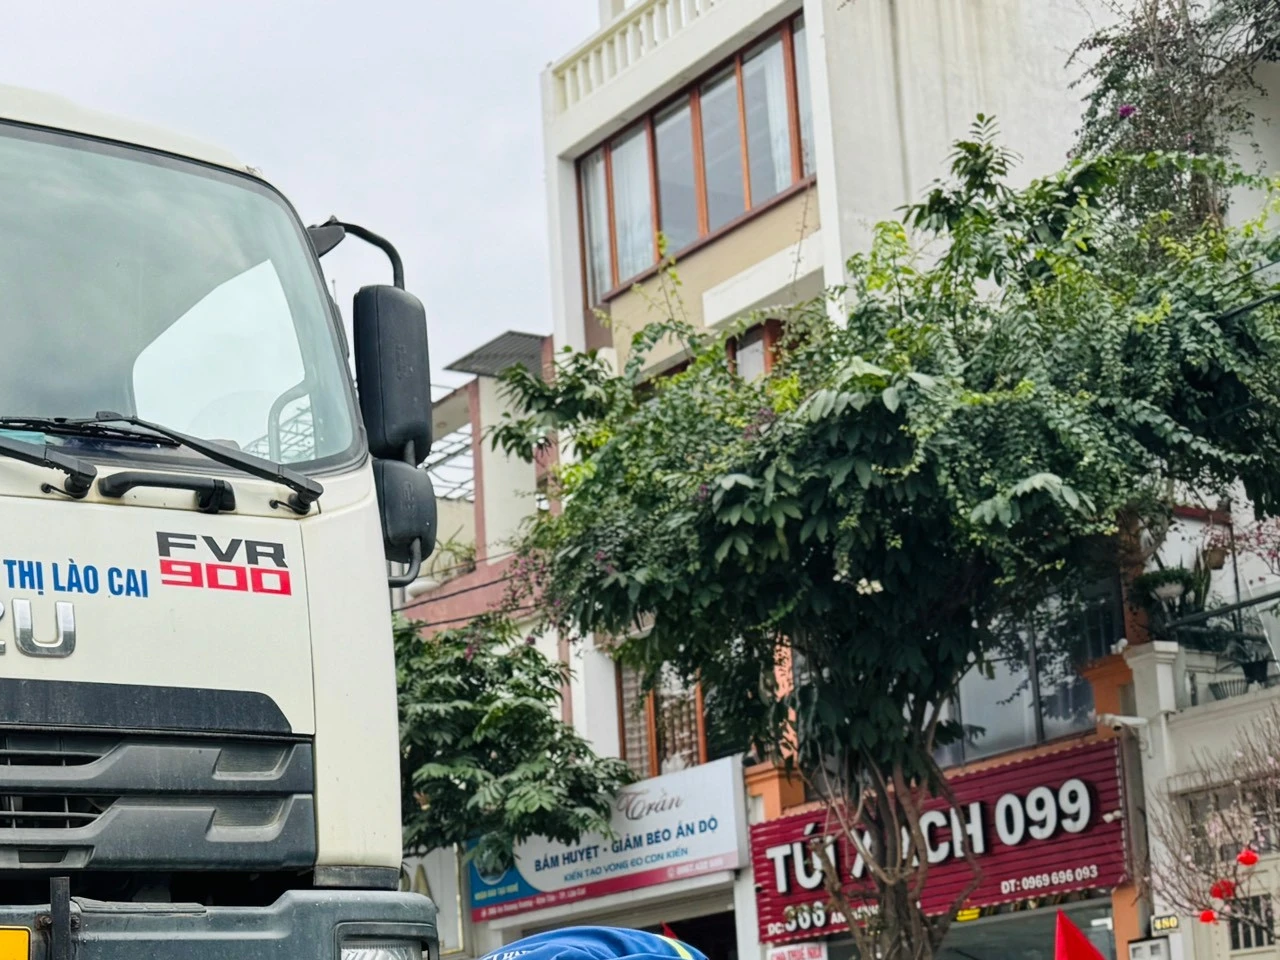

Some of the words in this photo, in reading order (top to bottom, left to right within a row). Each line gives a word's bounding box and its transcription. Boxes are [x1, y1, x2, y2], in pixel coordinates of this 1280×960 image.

[156, 531, 289, 568] FVR
[3, 559, 45, 596] THỊ
[52, 558, 100, 594] LÀO
[108, 569, 149, 598] CAI
[159, 559, 292, 596] 900
[995, 778, 1091, 846] 099
[1022, 874, 1050, 890] 0969
[1051, 869, 1073, 885] 696
[1075, 865, 1098, 881] 093
